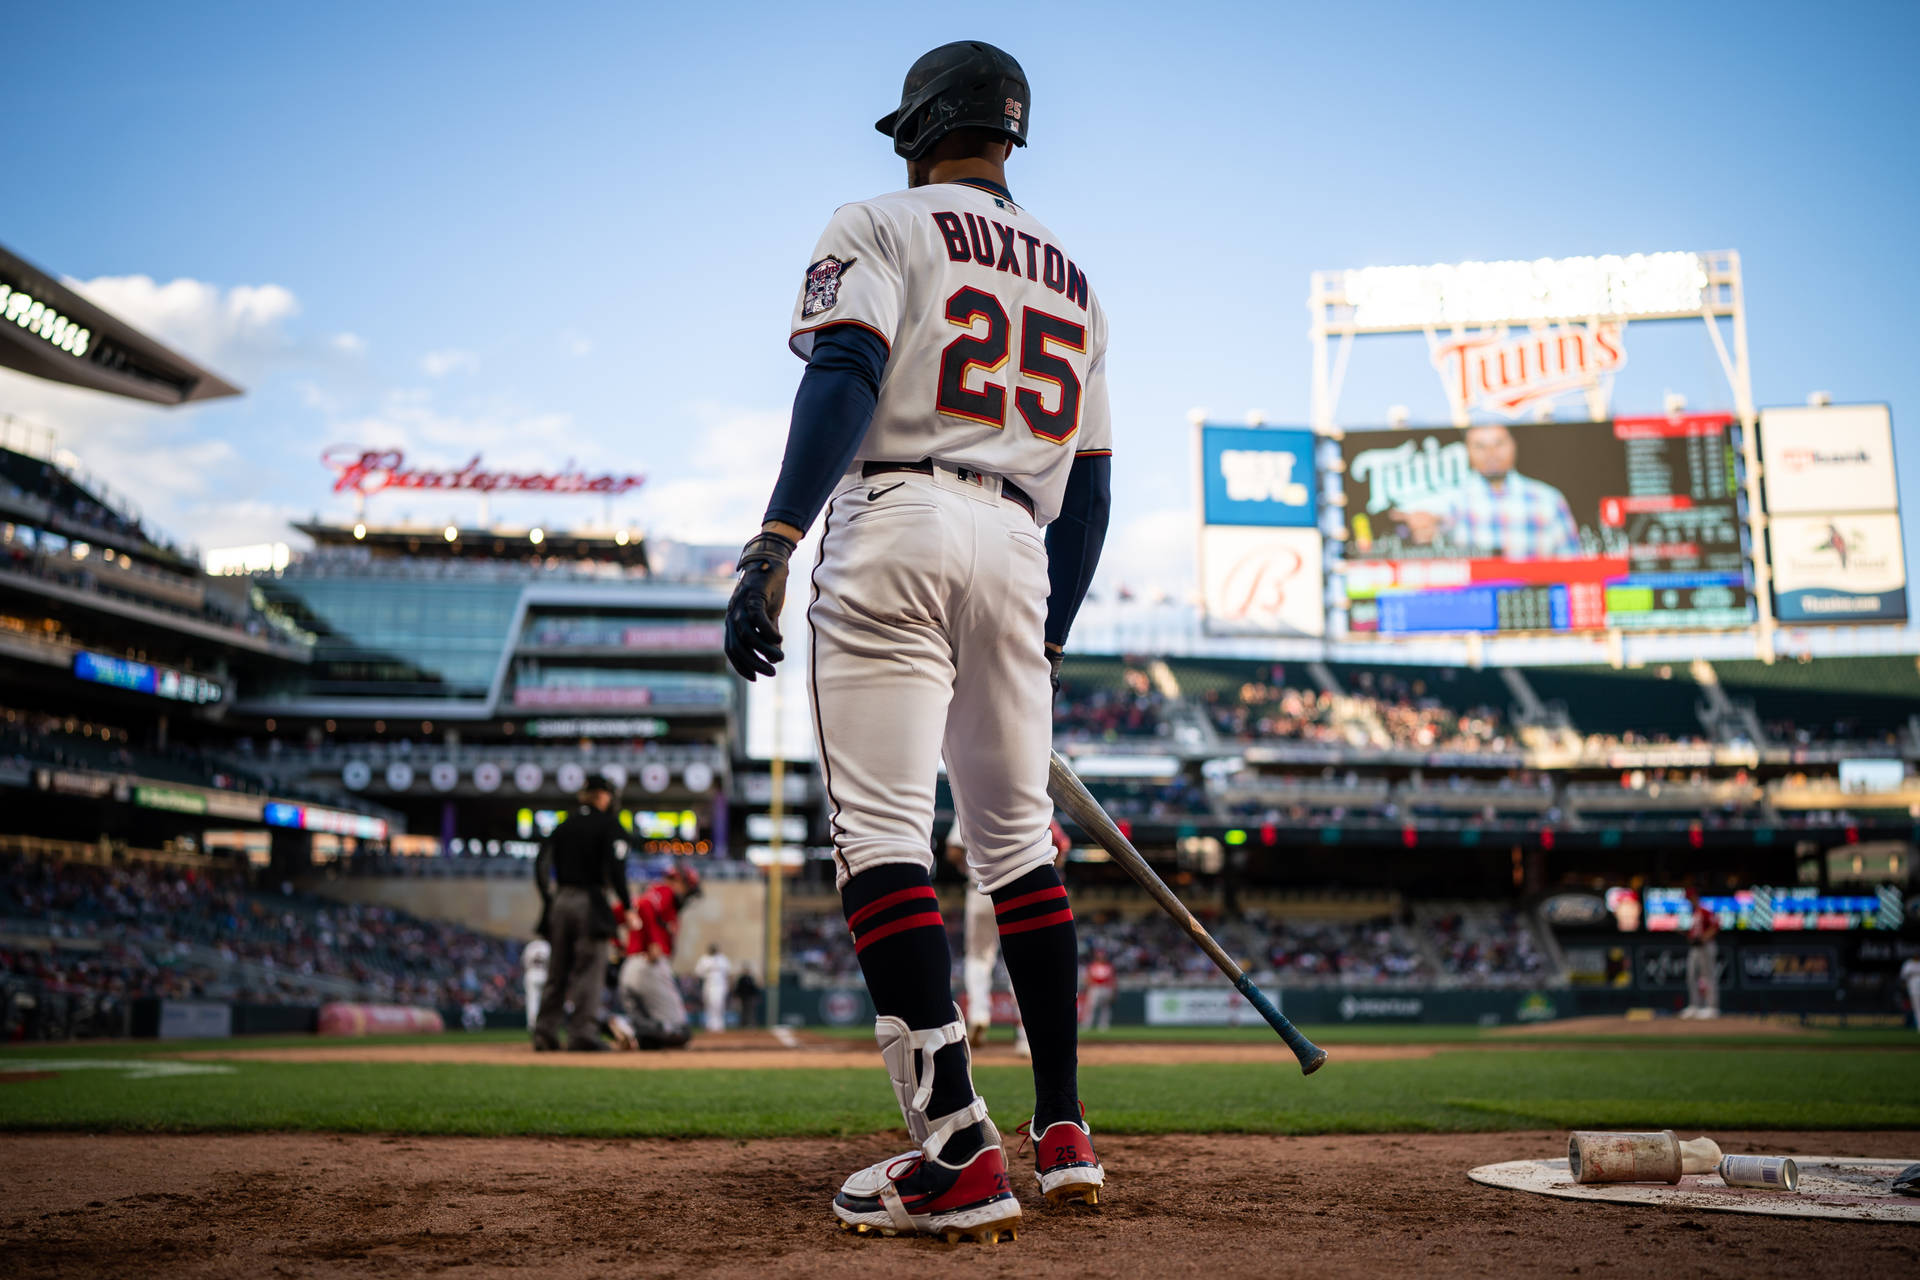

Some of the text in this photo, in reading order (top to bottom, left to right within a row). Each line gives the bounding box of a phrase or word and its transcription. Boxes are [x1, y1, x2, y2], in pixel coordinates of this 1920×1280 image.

[1004, 97, 1022, 120] 25
[808, 262, 841, 284] Twins
[931, 211, 1088, 312] BUXTON
[936, 284, 1087, 446] 25
[1438, 322, 1619, 406] Twins
[321, 442, 647, 495] Budweiser
[1350, 434, 1472, 515] Twin
[1055, 1144, 1078, 1162] 25
